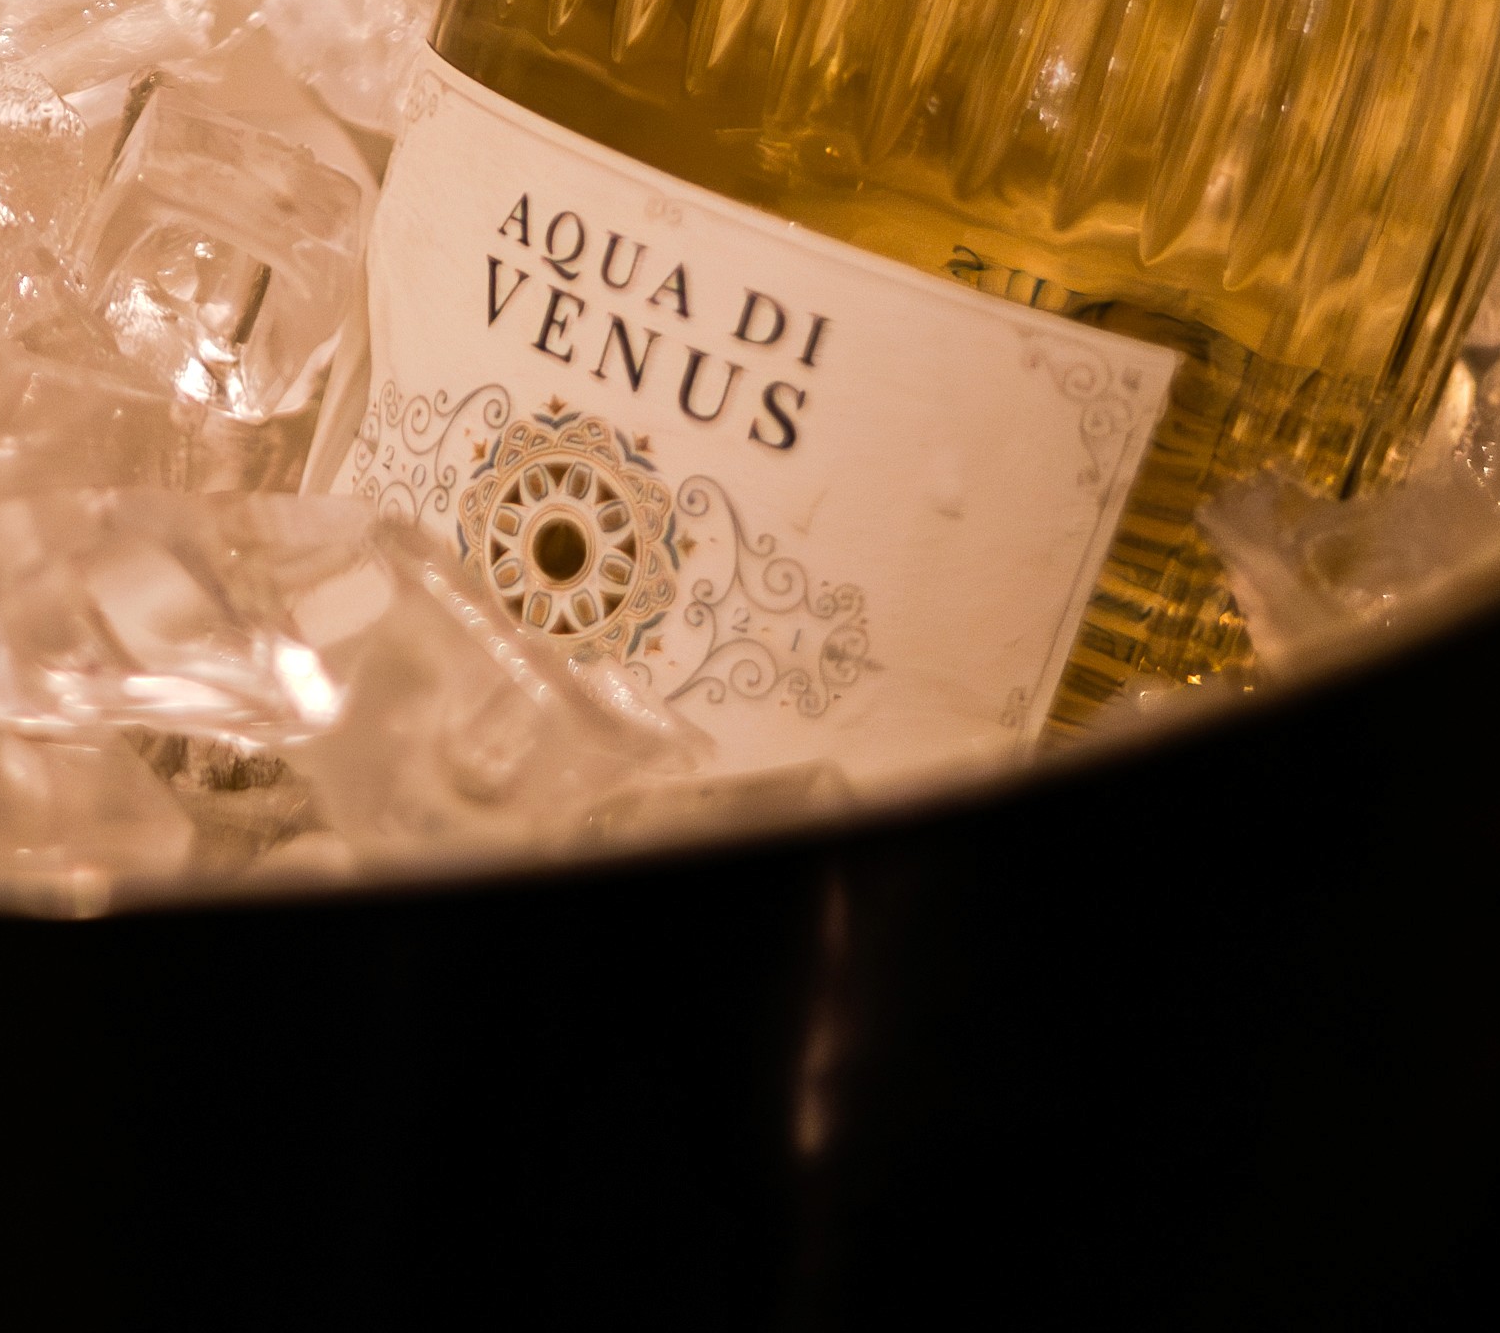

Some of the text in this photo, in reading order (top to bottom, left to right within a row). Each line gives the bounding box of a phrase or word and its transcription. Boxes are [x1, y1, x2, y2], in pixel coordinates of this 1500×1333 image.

[486, 253, 807, 450] VENUS
[497, 192, 832, 367] AQUA DI
